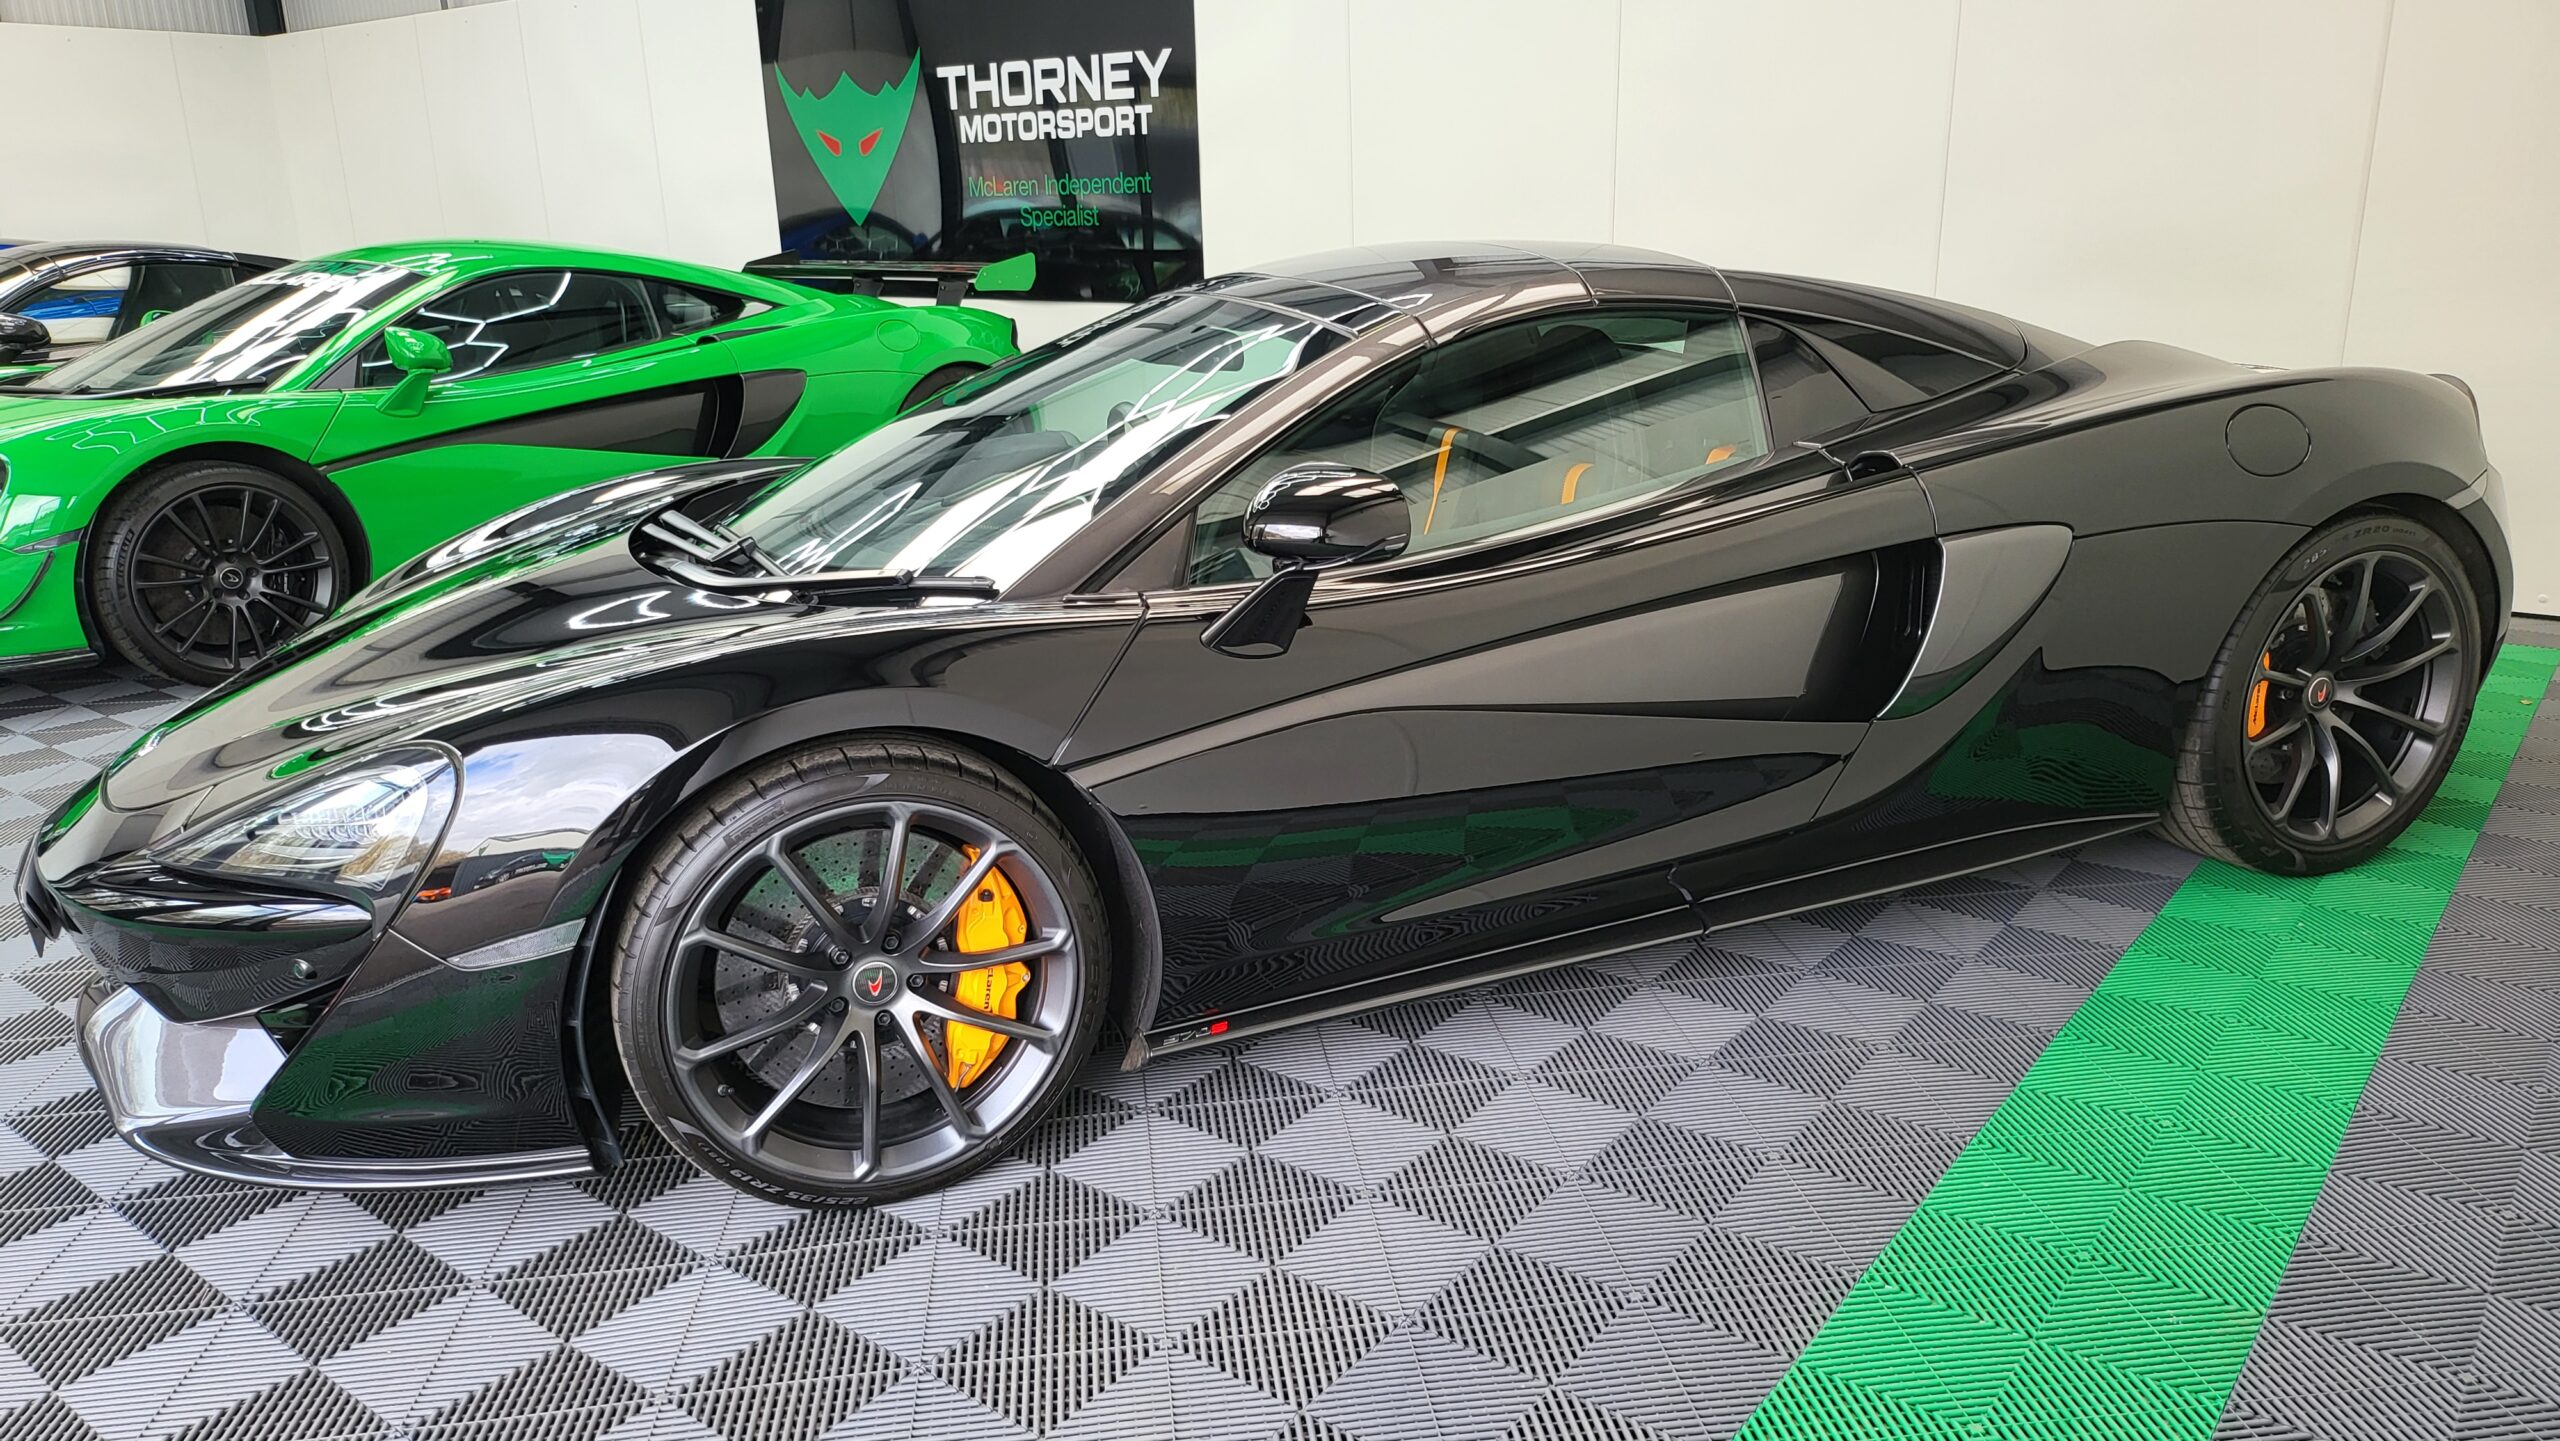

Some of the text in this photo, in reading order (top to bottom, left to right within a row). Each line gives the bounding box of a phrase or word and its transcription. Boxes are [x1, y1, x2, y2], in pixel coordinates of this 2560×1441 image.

[936, 48, 1172, 110] THORNEY
[959, 104, 1153, 144] MOTORSPORT
[968, 171, 1152, 200] McLaren Independent
[1020, 204, 1100, 231] Specialist
[729, 1168, 785, 1194] ZR19
